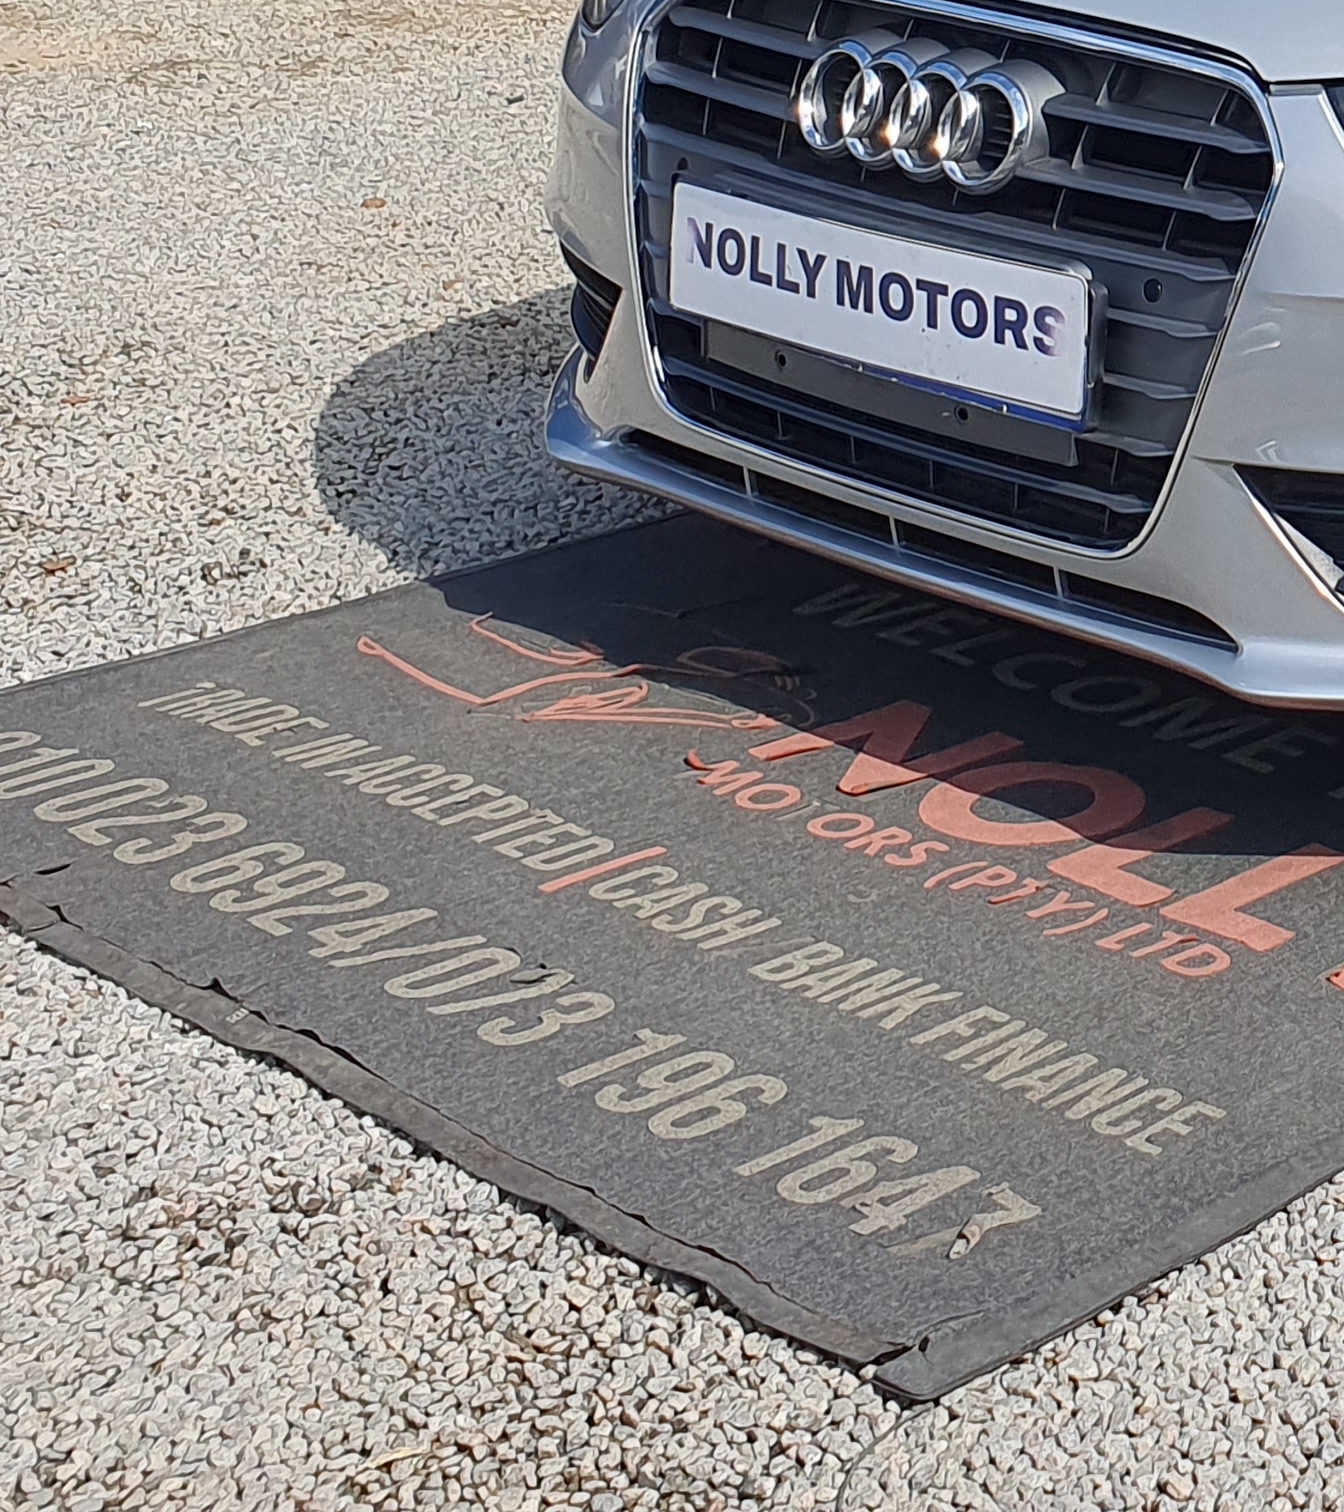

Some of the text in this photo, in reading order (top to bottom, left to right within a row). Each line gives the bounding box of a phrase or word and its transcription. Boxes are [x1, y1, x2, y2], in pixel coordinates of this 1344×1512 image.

[686, 217, 1066, 357] NOLLY MOTORS
[791, 582, 1335, 775] WELCOME
[137, 682, 331, 747] TRADE
[272, 732, 383, 769] IN
[748, 941, 964, 1030] BANK
[910, 1005, 1228, 1156] FINANCE
[1095, 922, 1233, 977] LTD
[34, 778, 249, 865] 023
[557, 1027, 788, 1140] 196
[733, 1114, 1043, 1260] 1647
